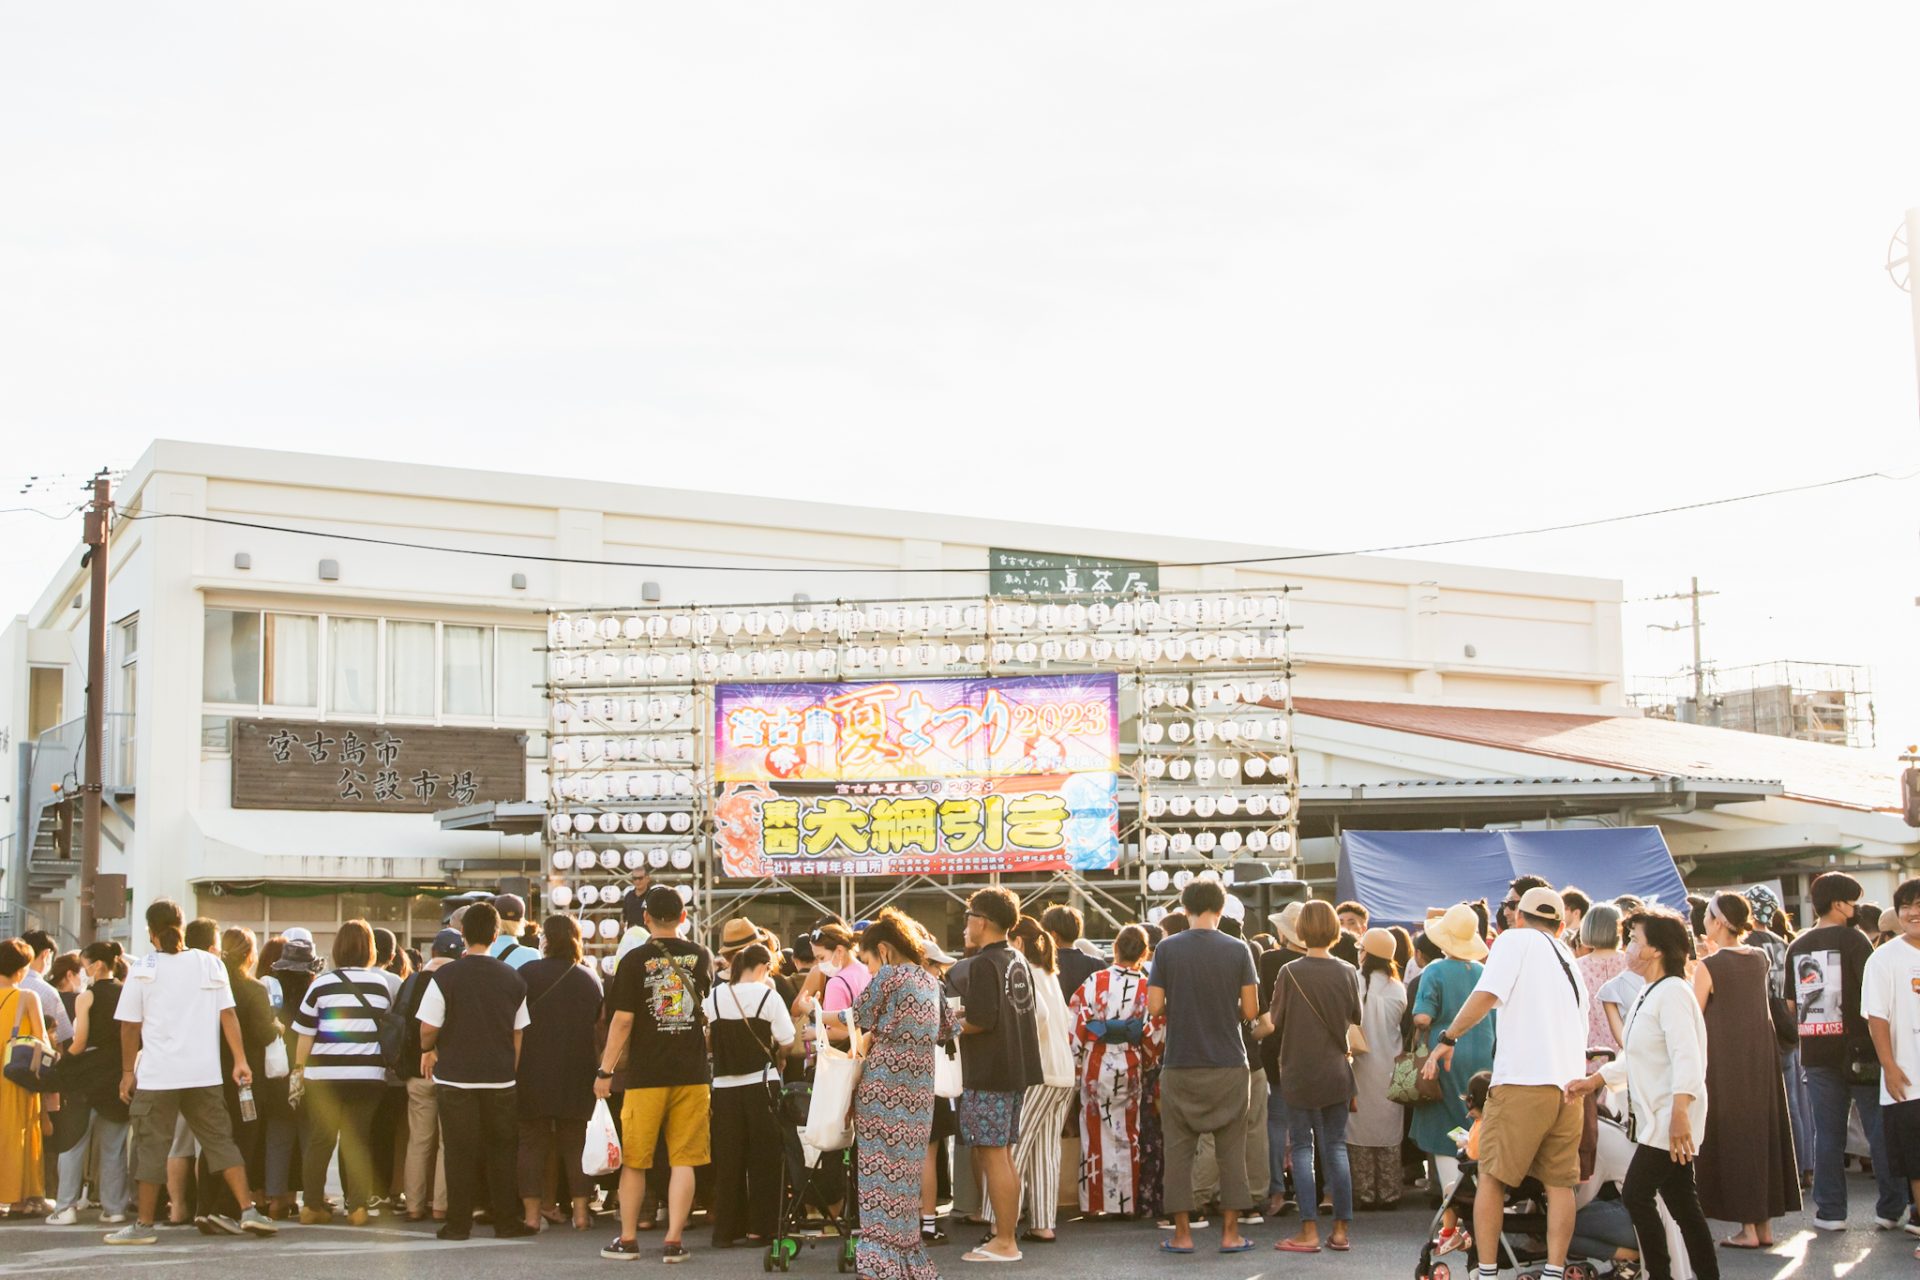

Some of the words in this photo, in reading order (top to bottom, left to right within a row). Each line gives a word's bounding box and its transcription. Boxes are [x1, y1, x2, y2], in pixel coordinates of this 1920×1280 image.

[267, 729, 404, 768] 宮古島市
[337, 767, 479, 804] 公設市場
